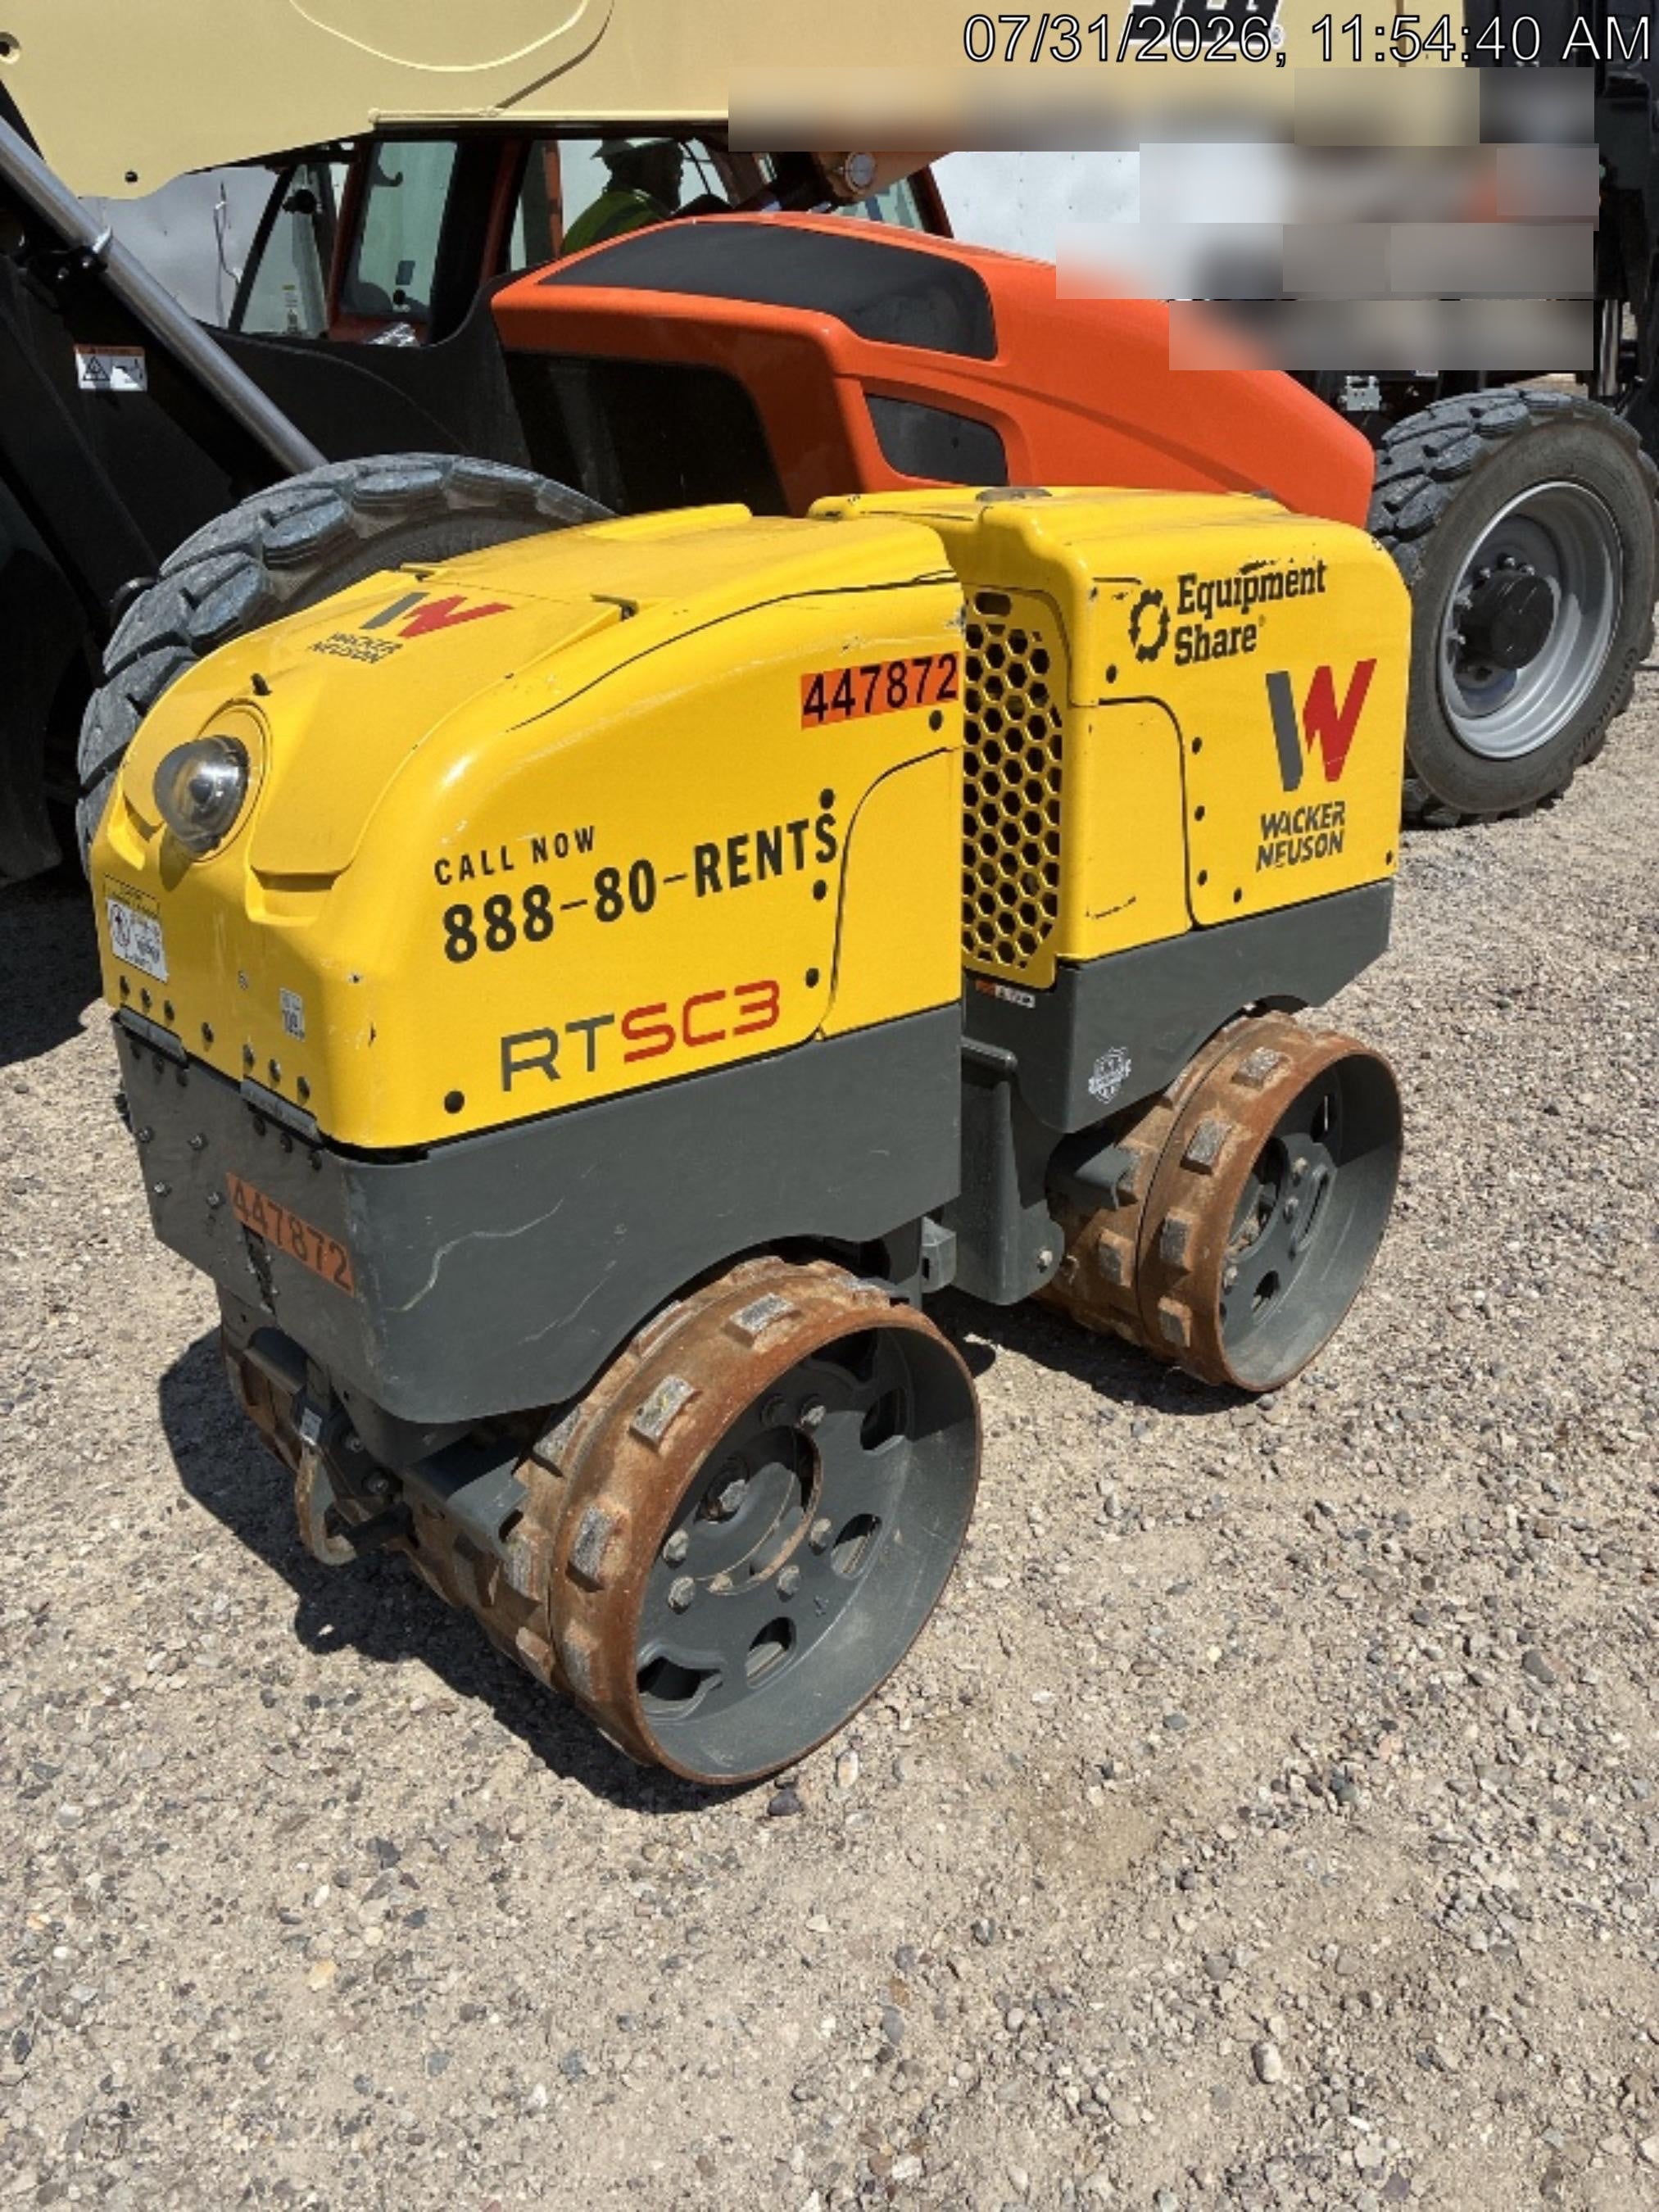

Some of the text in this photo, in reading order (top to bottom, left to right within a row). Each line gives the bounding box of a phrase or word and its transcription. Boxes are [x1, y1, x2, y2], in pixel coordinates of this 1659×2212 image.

[1177, 559, 1327, 619] Equipment
[802, 653, 958, 723] 447872
[1256, 830, 1344, 873] NEUSON
[1259, 800, 1345, 841] WACKER
[434, 826, 596, 886] CALL NOW
[443, 814, 837, 963] 888-80-RENTS
[500, 980, 780, 1091] RTSC3
[234, 1181, 351, 1291] 447872
